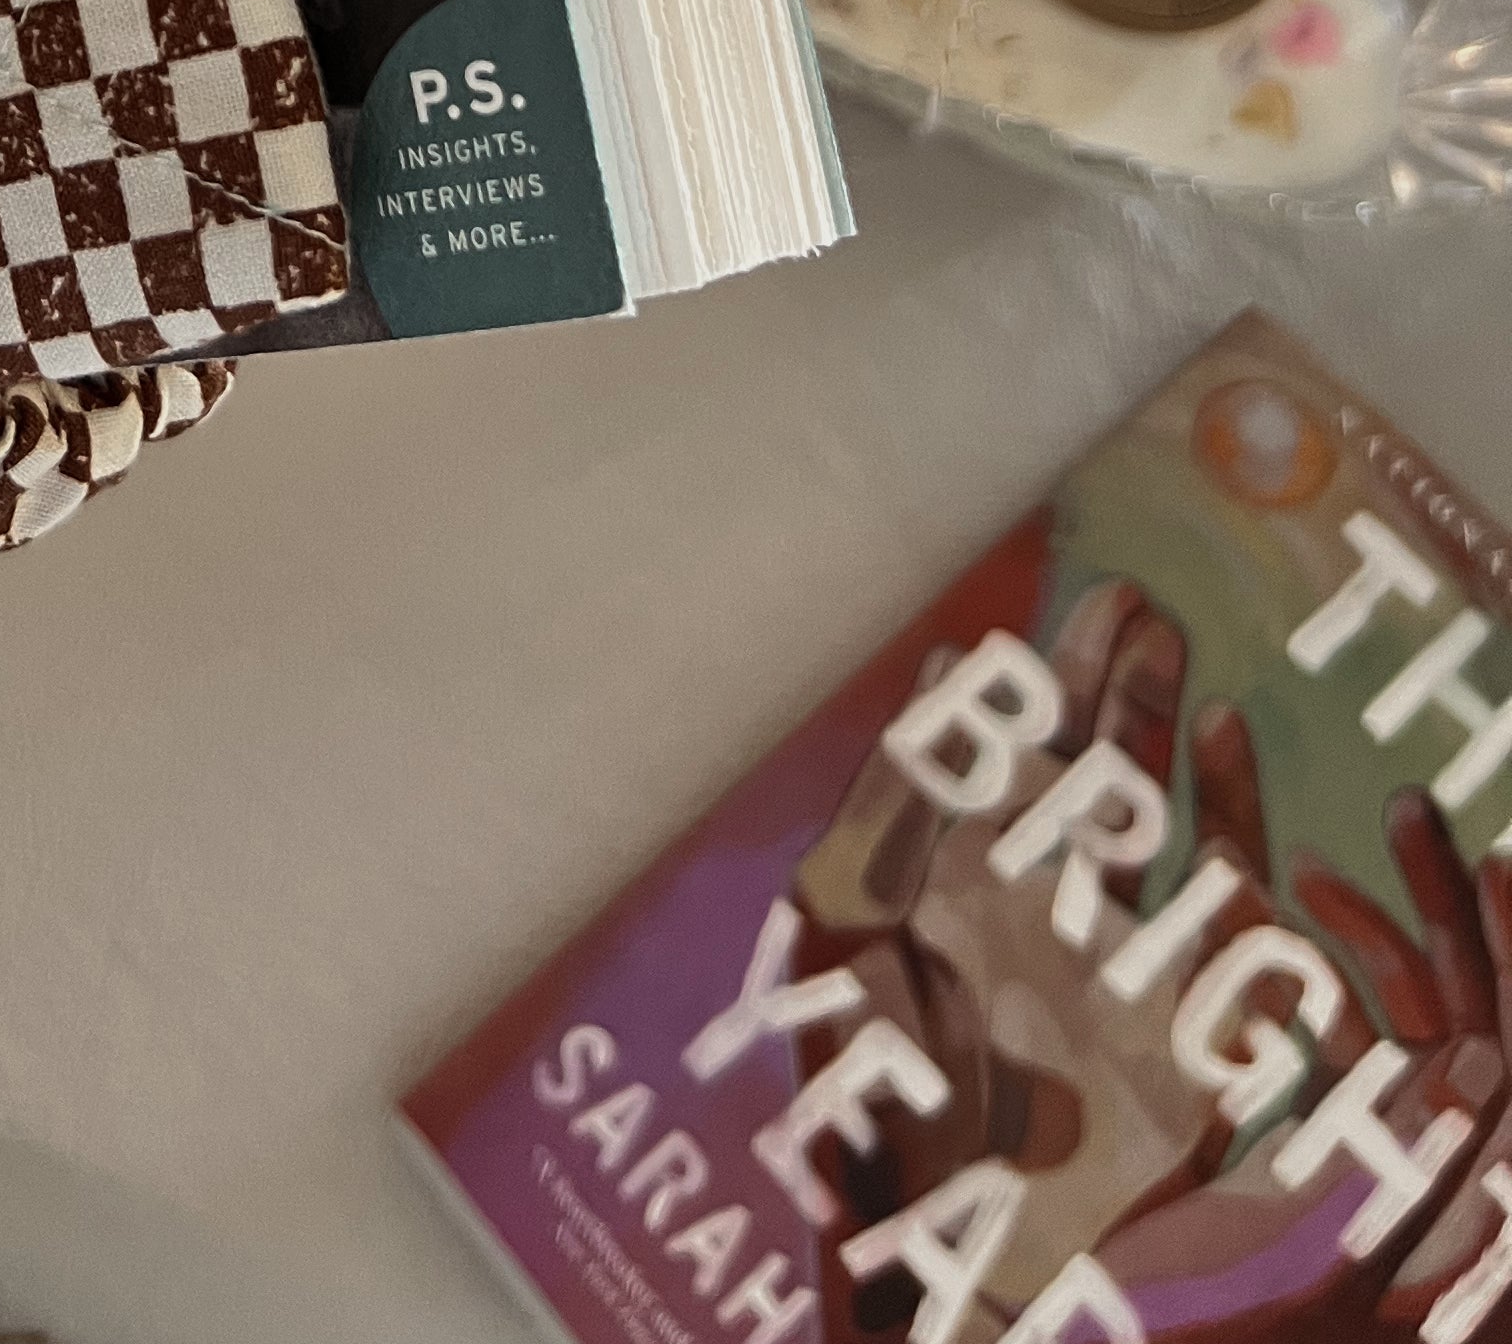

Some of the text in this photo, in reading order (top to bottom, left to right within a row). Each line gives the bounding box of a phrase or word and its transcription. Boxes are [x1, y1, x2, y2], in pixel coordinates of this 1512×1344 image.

[409, 59, 527, 124] P.S.
[377, 173, 545, 218] INTERVIEWS
[420, 232, 438, 259] &
[1286, 508, 1512, 860] TH
[532, 1022, 819, 1344] SARAH
